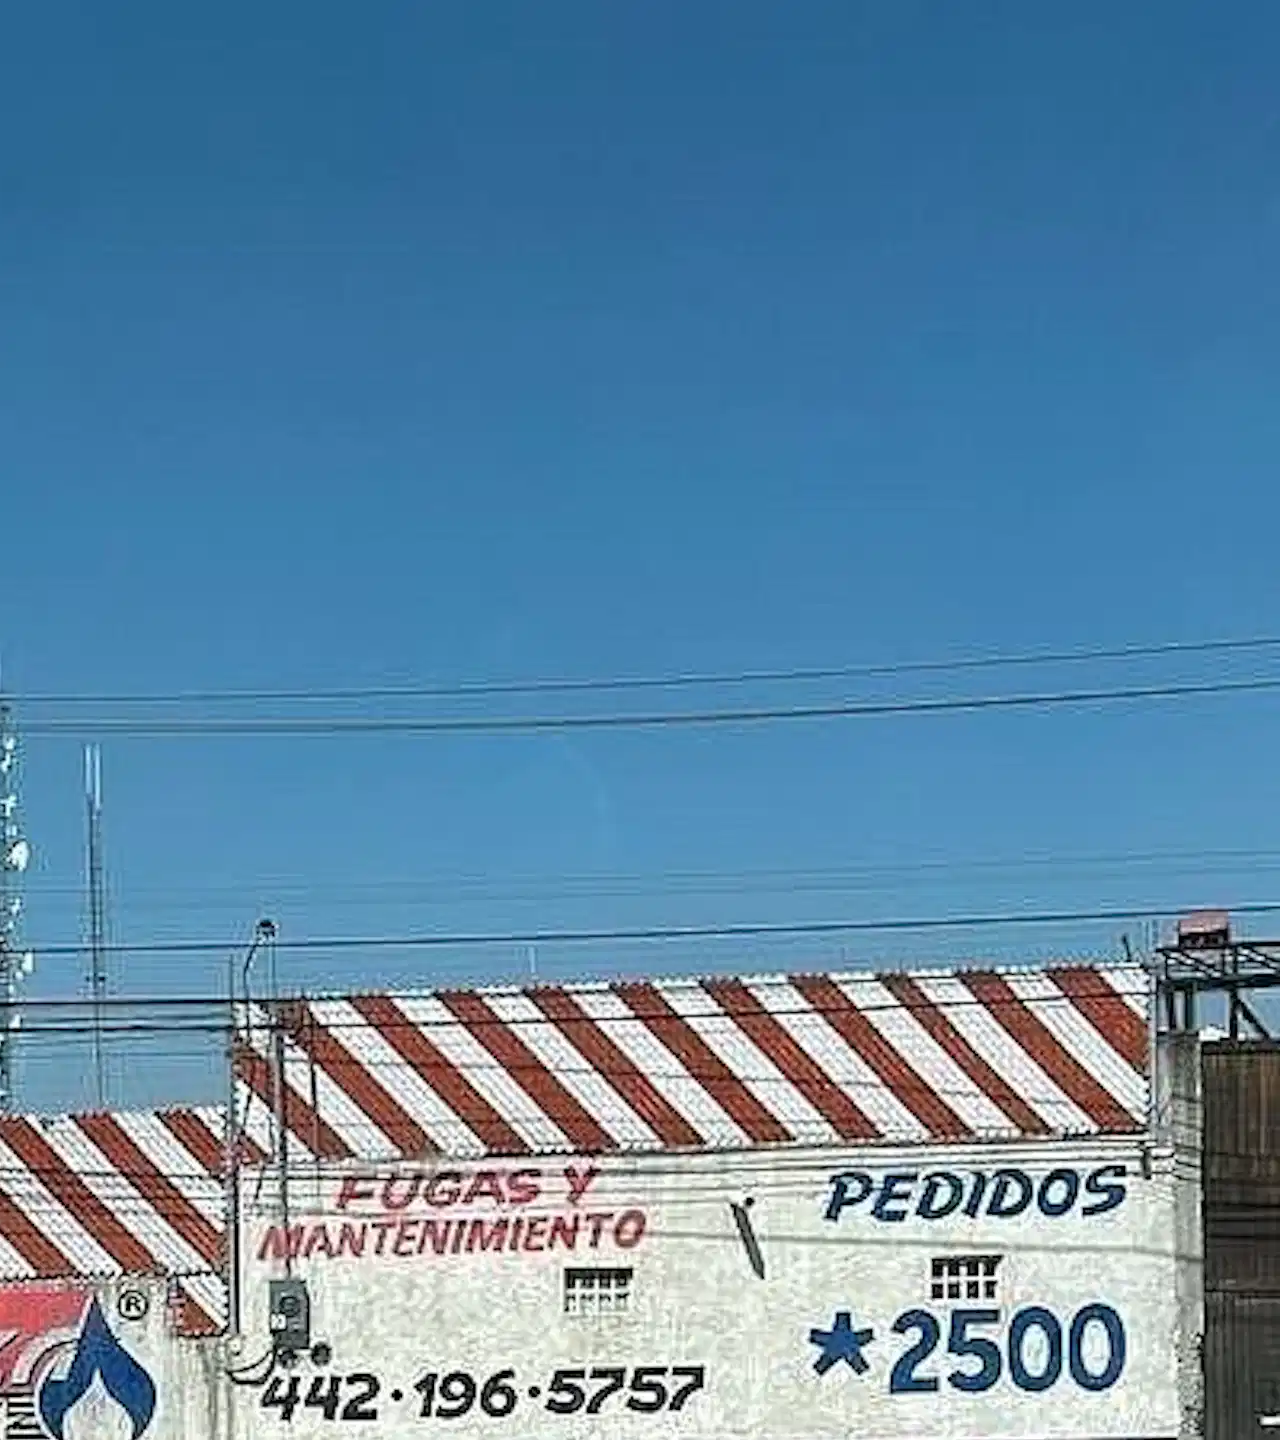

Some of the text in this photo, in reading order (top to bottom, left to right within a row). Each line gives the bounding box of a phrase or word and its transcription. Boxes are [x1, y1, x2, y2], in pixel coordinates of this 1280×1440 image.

[335, 1165, 601, 1210] FUGAS Y
[823, 1164, 1127, 1222] PEDIDOS
[256, 1209, 647, 1261] MANTENIMIENTO
